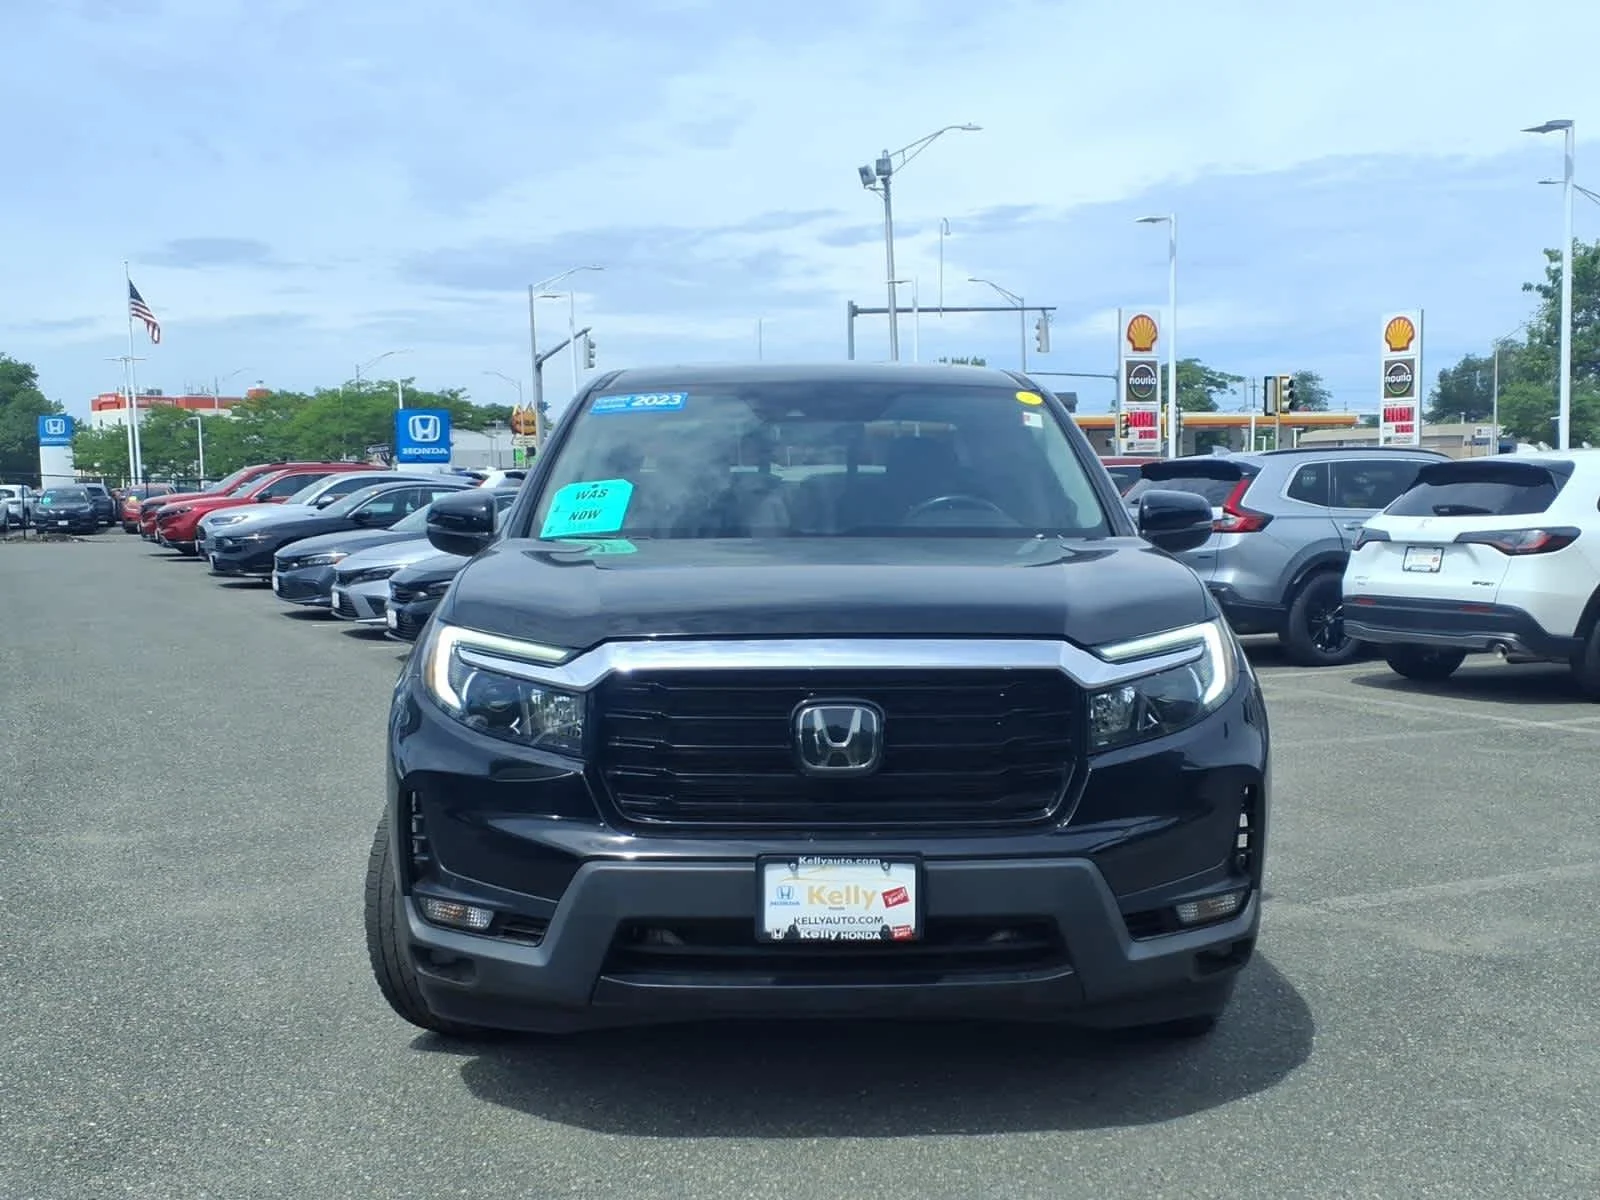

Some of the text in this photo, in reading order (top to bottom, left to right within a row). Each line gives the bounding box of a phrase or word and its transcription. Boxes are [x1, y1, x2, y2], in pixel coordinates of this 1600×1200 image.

[1129, 375, 1157, 385] nouria
[631, 394, 682, 407] 2023
[401, 447, 448, 455] HONDA
[575, 489, 609, 500] WAS
[568, 508, 603, 521] NOW
[798, 856, 881, 866] Kellyauto.com
[807, 885, 878, 911] Kelly
[793, 916, 884, 926] KELLYAUTO.COM
[800, 927, 838, 940] Kelly
[840, 931, 882, 940] HONDA
